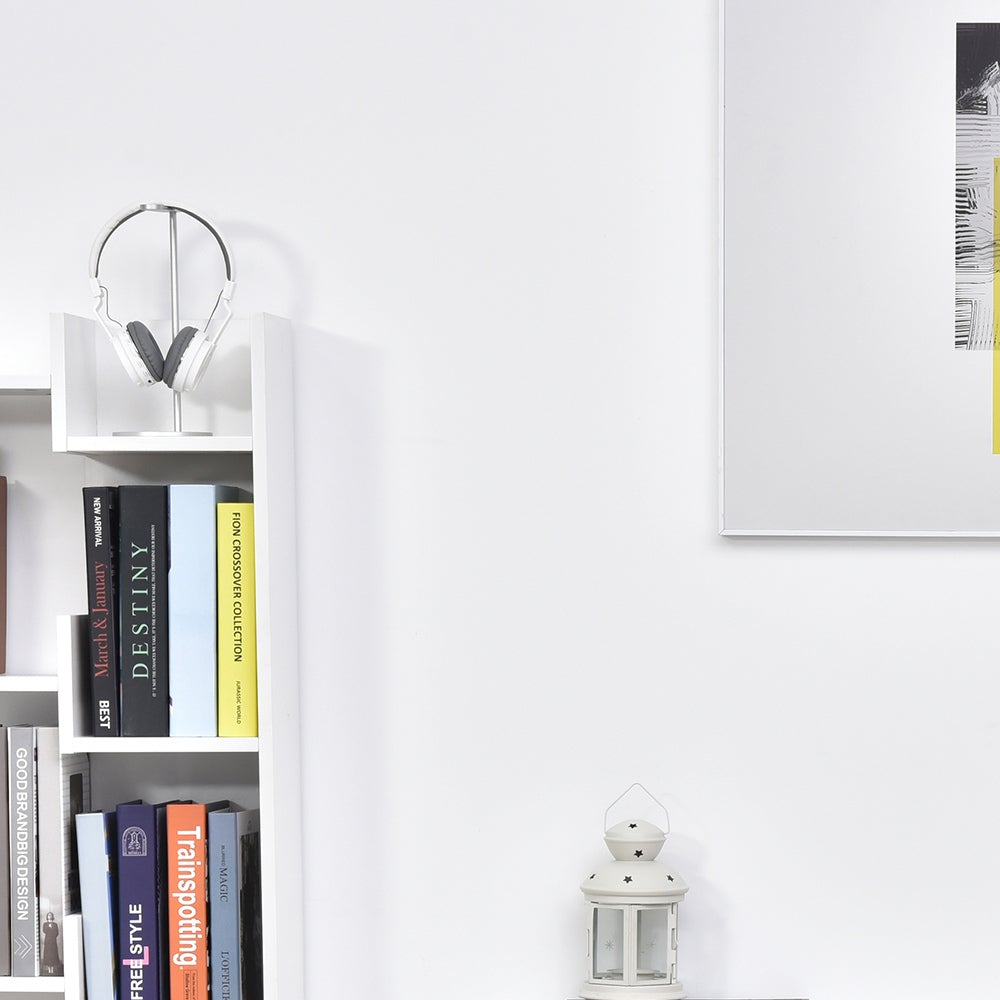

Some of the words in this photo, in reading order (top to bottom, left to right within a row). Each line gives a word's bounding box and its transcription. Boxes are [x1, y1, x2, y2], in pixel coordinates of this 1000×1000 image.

[93, 497, 101, 515] NEW
[232, 512, 241, 536] FION
[94, 515, 103, 547] ARRIVAL
[92, 561, 109, 615] January
[233, 539, 242, 599] CROSSOVER
[92, 618, 107, 629] &
[131, 542, 149, 679] DESTINY
[233, 601, 243, 662] COLLECTION
[94, 633, 109, 677] March
[99, 701, 110, 728] BEST
[219, 867, 229, 903] MAGIC
[128, 903, 143, 955] STYLE
[130, 957, 144, 1000] FREE
